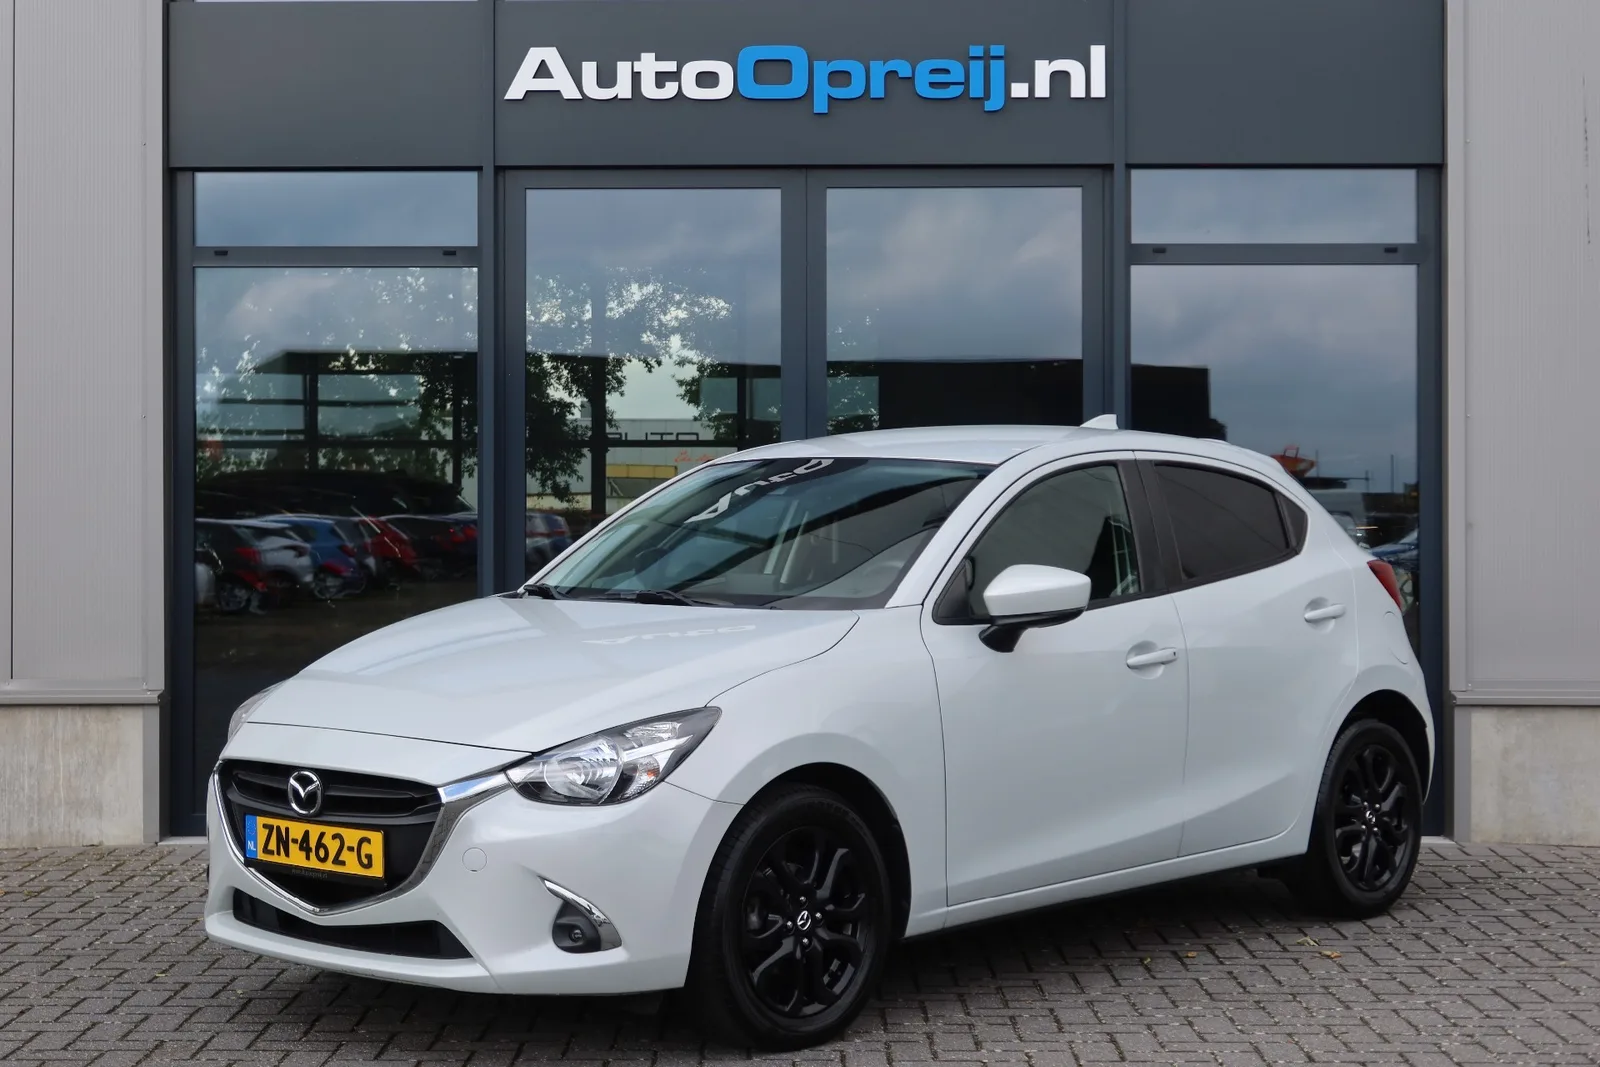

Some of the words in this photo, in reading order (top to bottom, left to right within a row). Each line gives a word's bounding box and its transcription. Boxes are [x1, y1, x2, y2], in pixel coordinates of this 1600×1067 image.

[503, 44, 1107, 114] AutoOpreij.nl
[247, 840, 256, 851] NL
[262, 824, 373, 869] ZN-462-G
